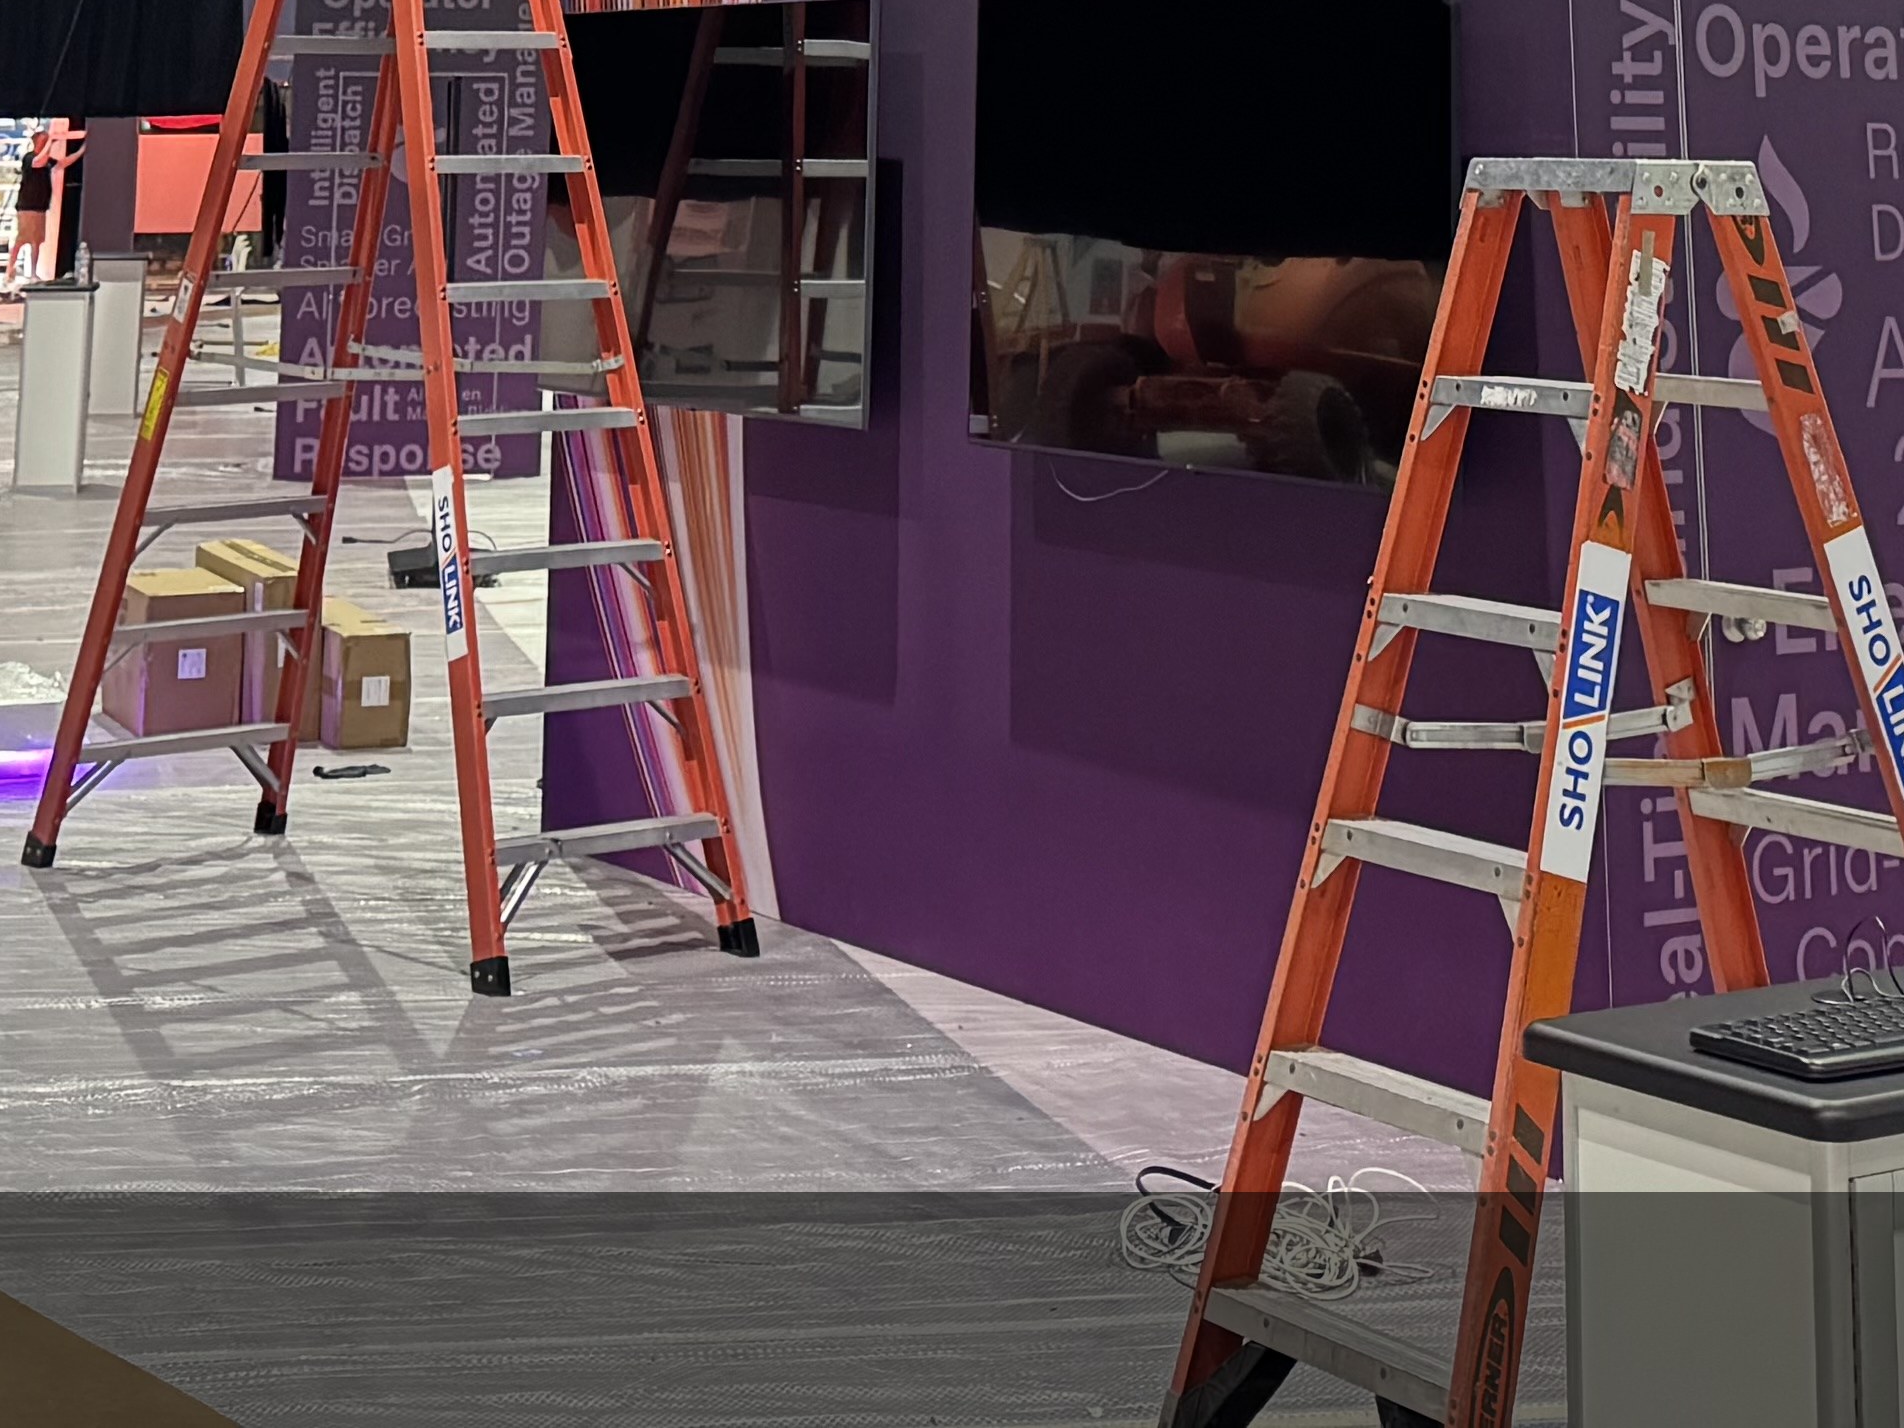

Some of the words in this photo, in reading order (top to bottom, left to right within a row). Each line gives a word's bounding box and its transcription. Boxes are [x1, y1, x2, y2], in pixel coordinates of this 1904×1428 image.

[308, 67, 336, 207] Intlligent
[296, 384, 400, 423] Fult
[294, 437, 502, 477] Rspose
[1573, 606, 1612, 709] LINK
[1848, 574, 1892, 667] SHO
[1558, 729, 1594, 831] SHO
